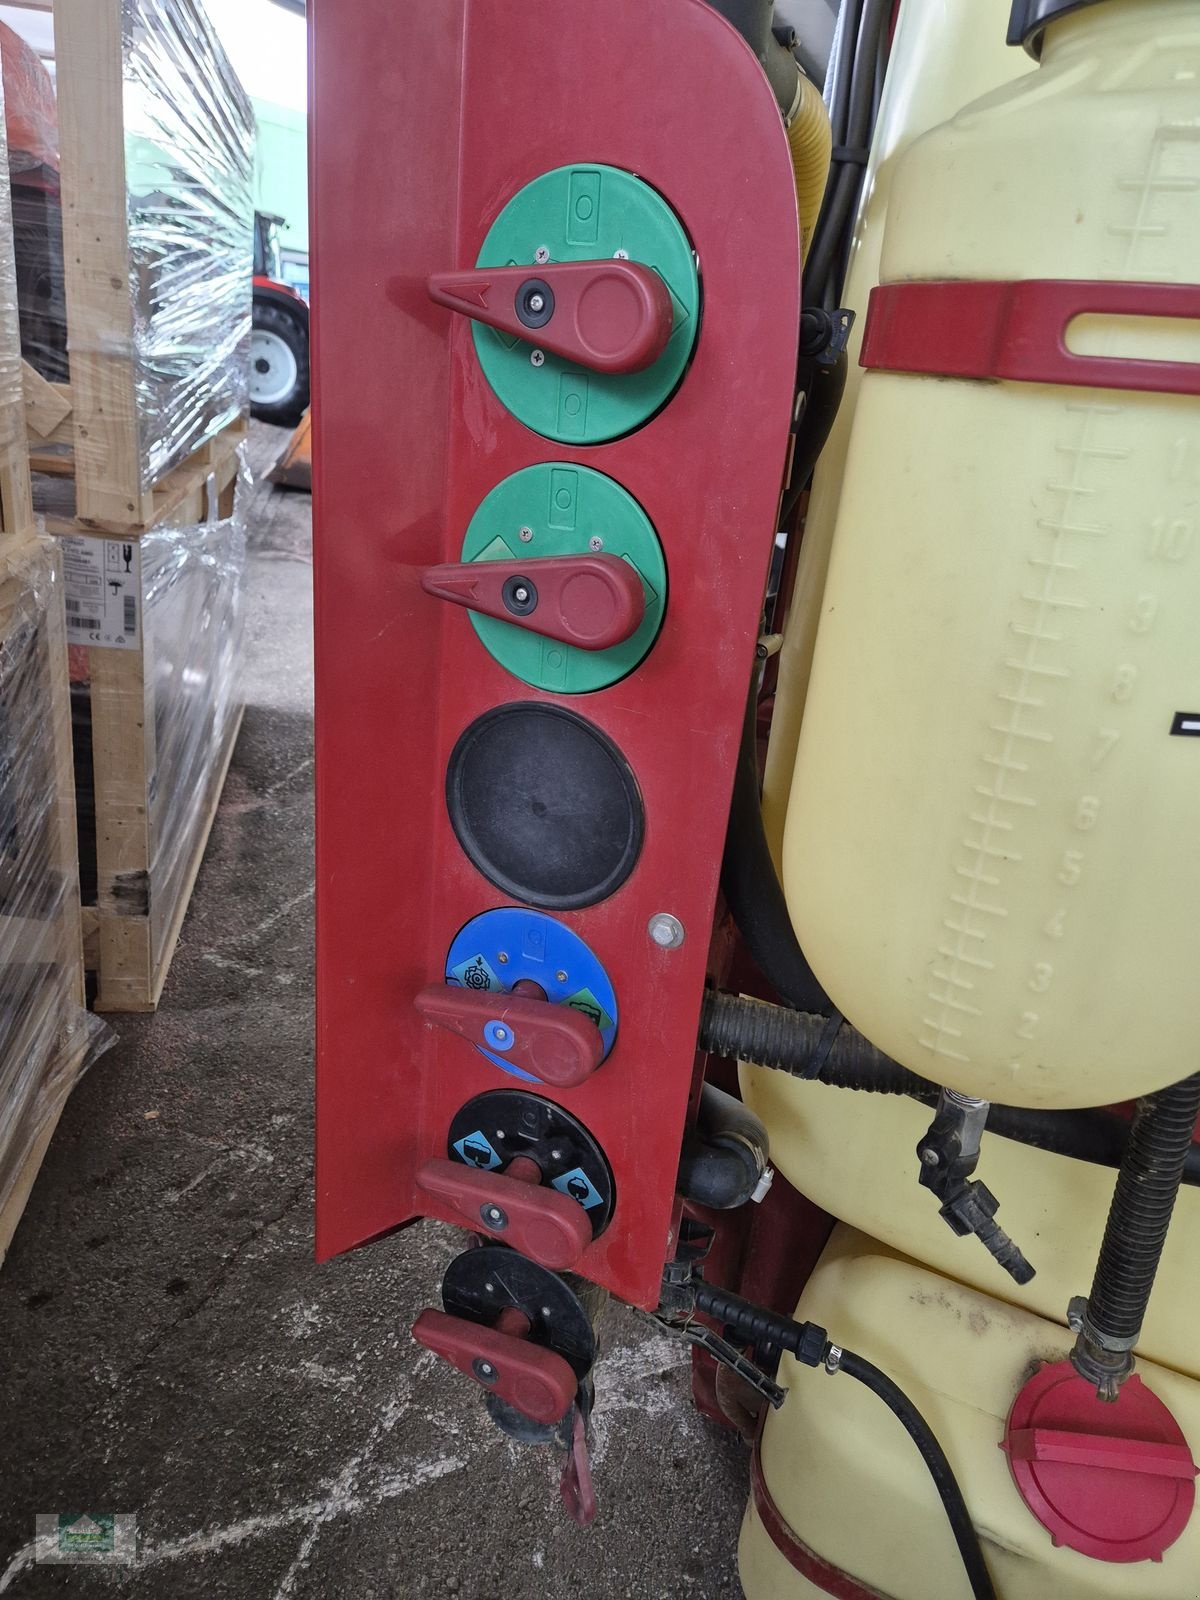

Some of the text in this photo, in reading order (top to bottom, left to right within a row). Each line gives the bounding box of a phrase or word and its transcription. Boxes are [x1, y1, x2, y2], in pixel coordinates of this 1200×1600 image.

[1058, 849, 1085, 886] 5
[1028, 962, 1054, 993] 3
[1015, 1010, 1040, 1040] 2
